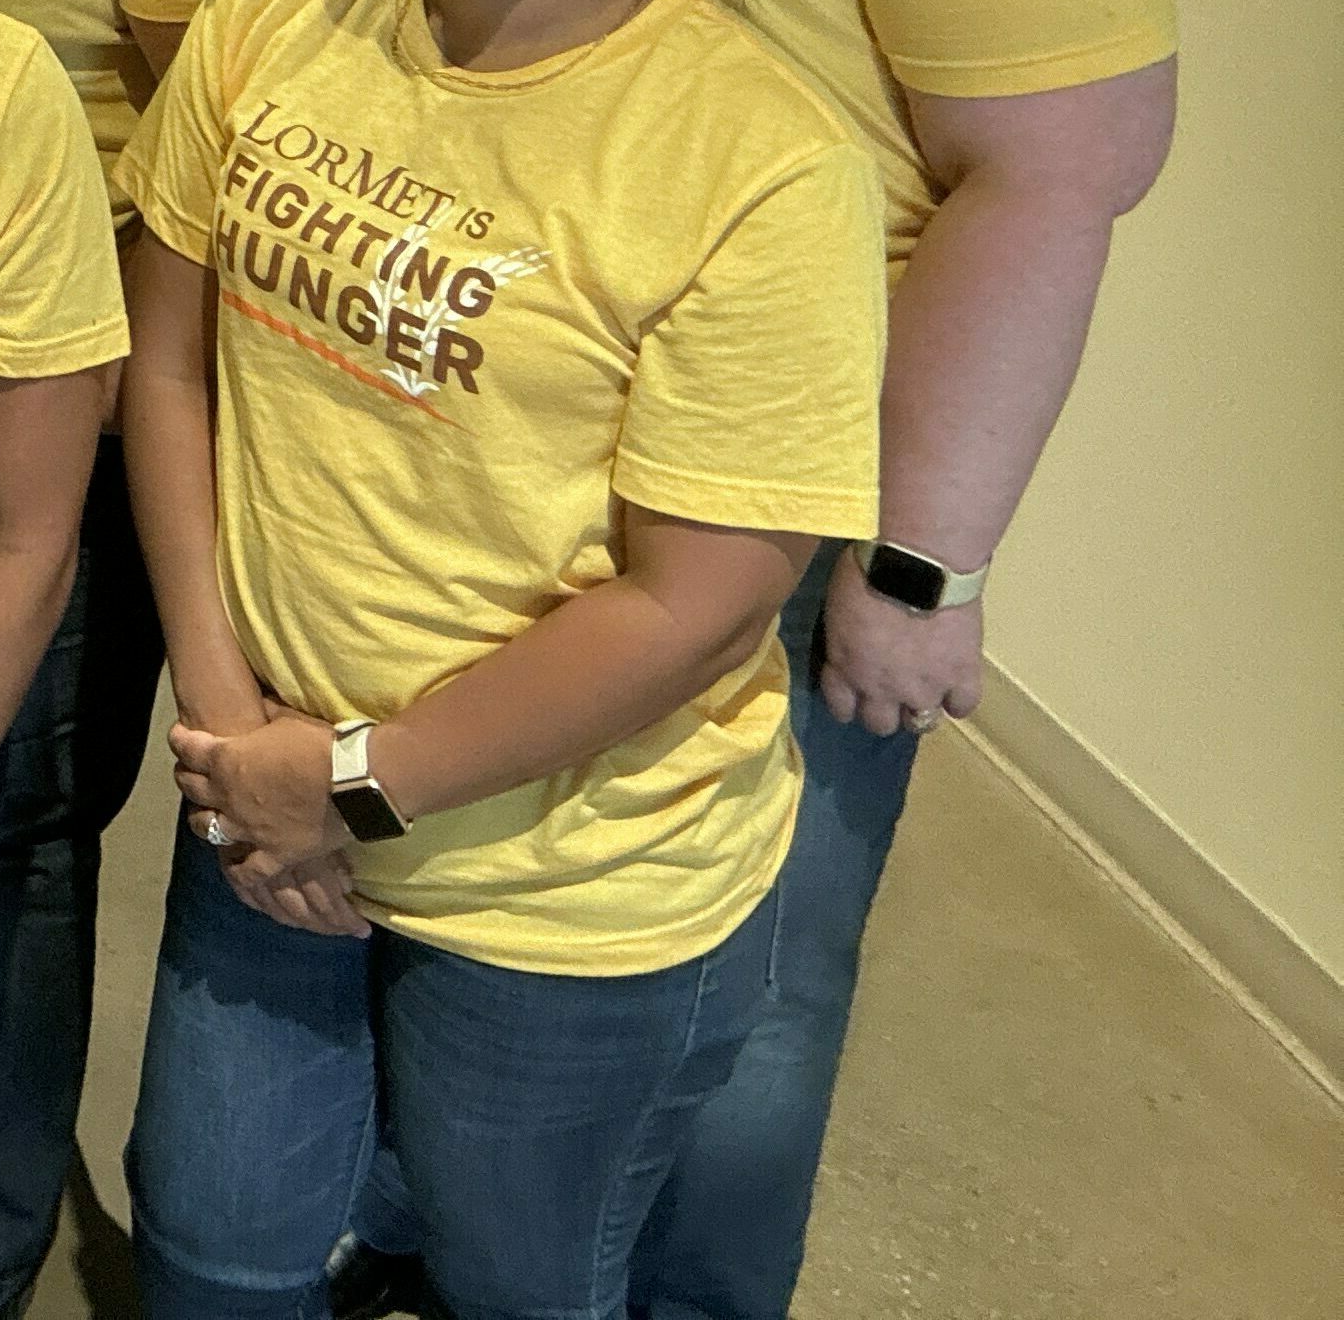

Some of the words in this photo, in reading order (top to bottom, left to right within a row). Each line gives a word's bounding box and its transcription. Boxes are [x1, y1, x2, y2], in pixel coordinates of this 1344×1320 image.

[217, 209, 485, 395] HUNGER
[224, 152, 497, 319] FIGHTING
[455, 206, 496, 240] IS
